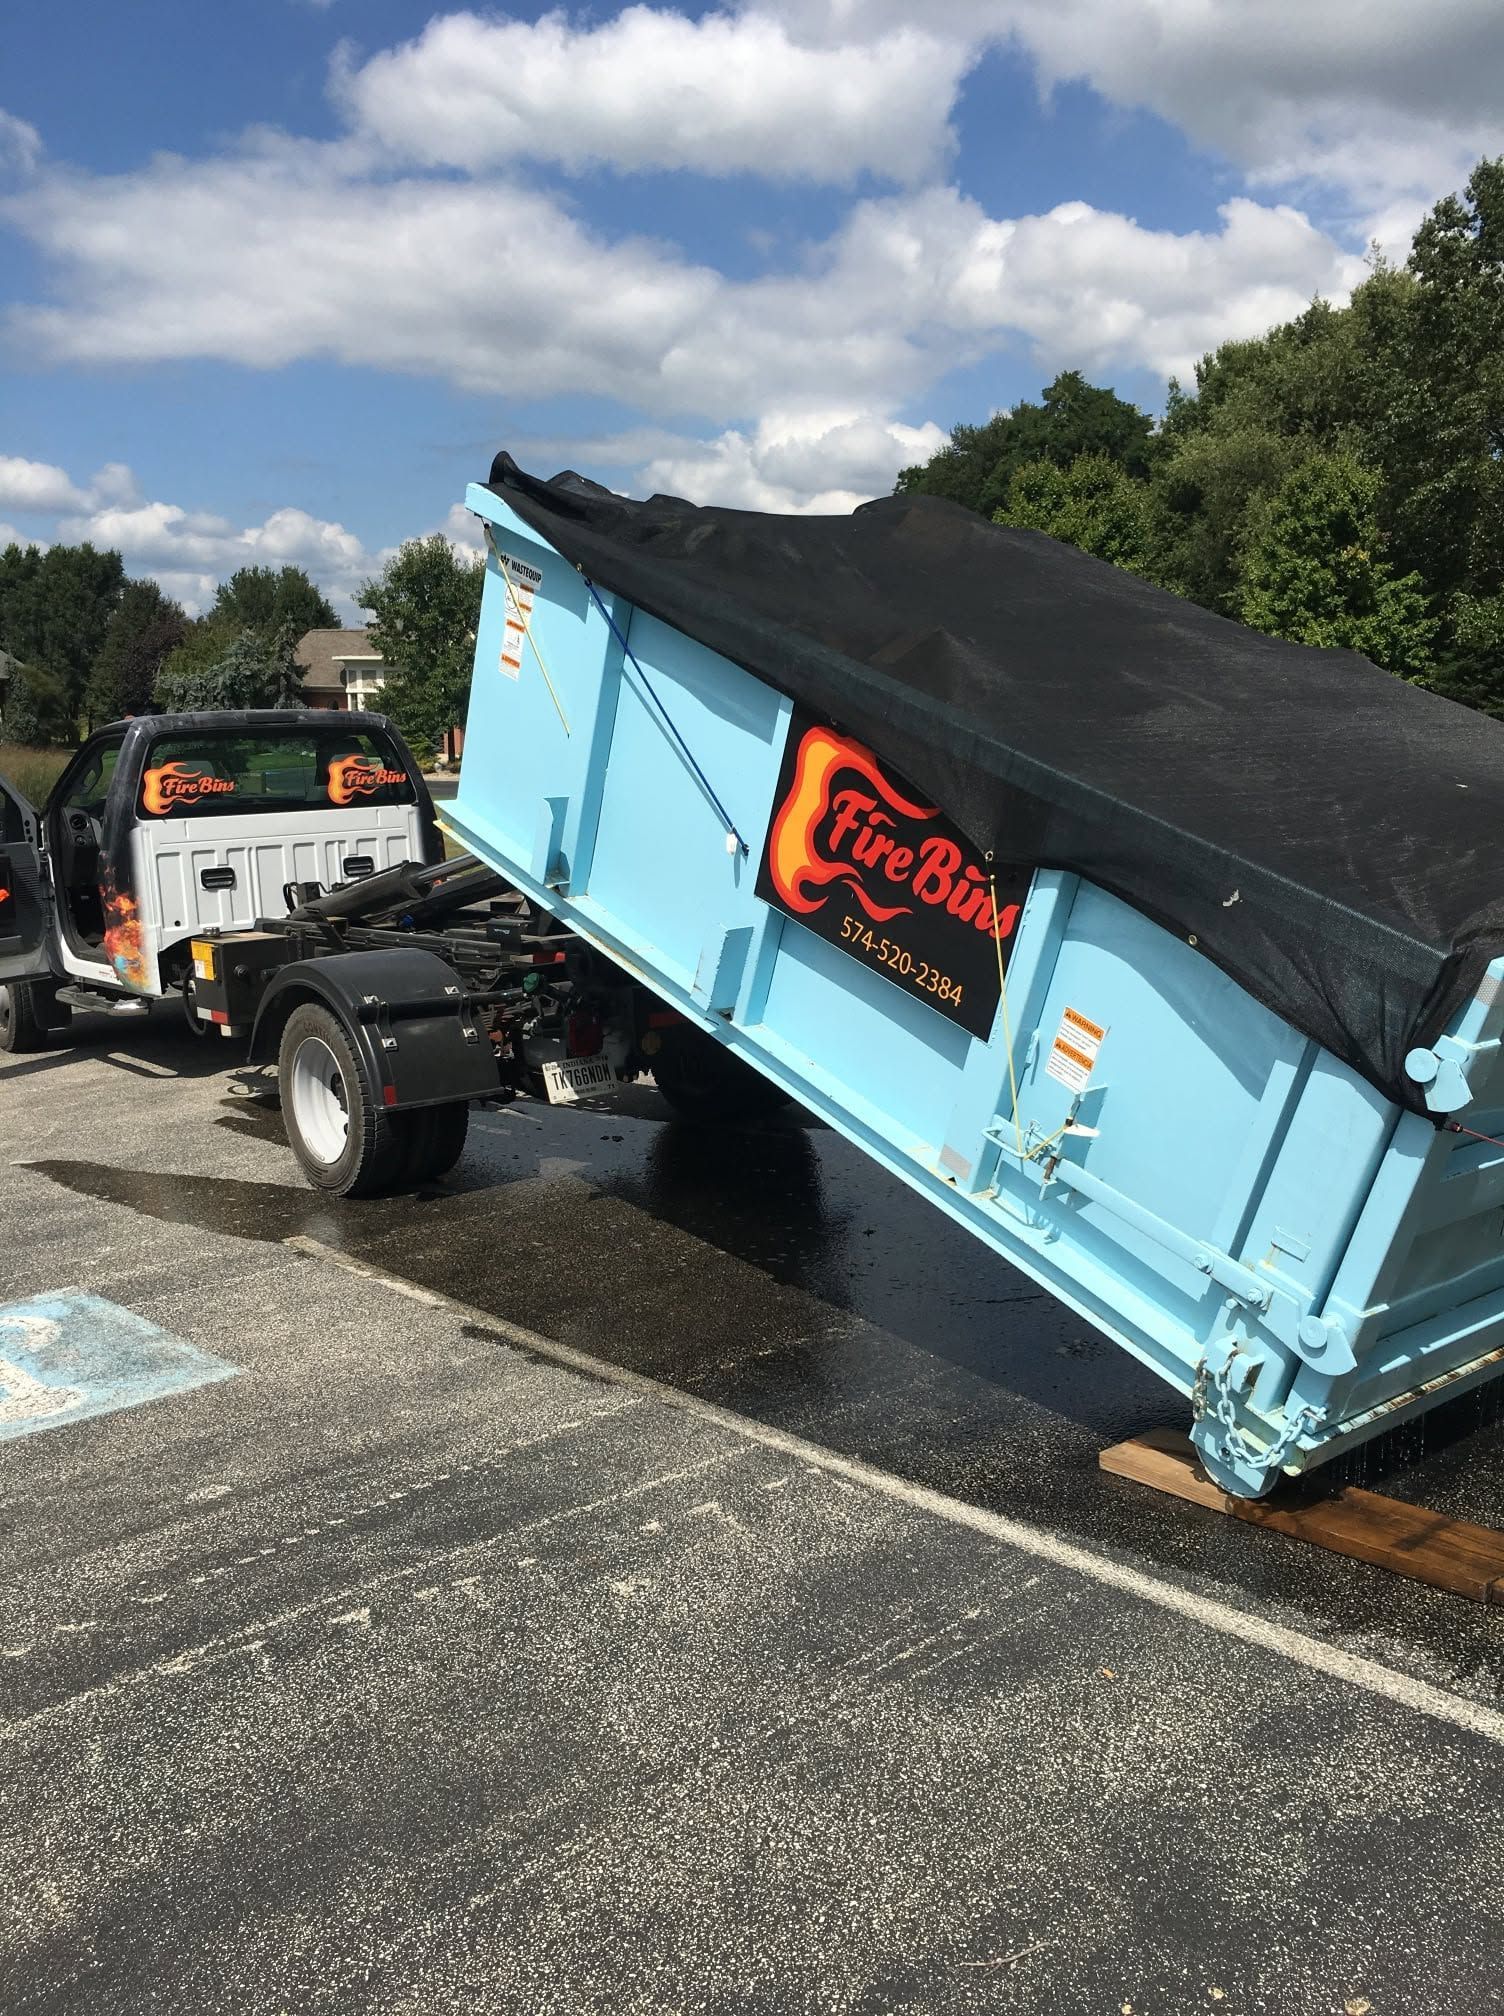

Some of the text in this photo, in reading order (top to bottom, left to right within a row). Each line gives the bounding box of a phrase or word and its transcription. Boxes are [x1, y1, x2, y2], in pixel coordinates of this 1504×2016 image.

[511, 559, 542, 583] WASTEQUIP
[839, 915, 964, 1008] 574-520-2384
[1071, 1013, 1102, 1038] WARNING
